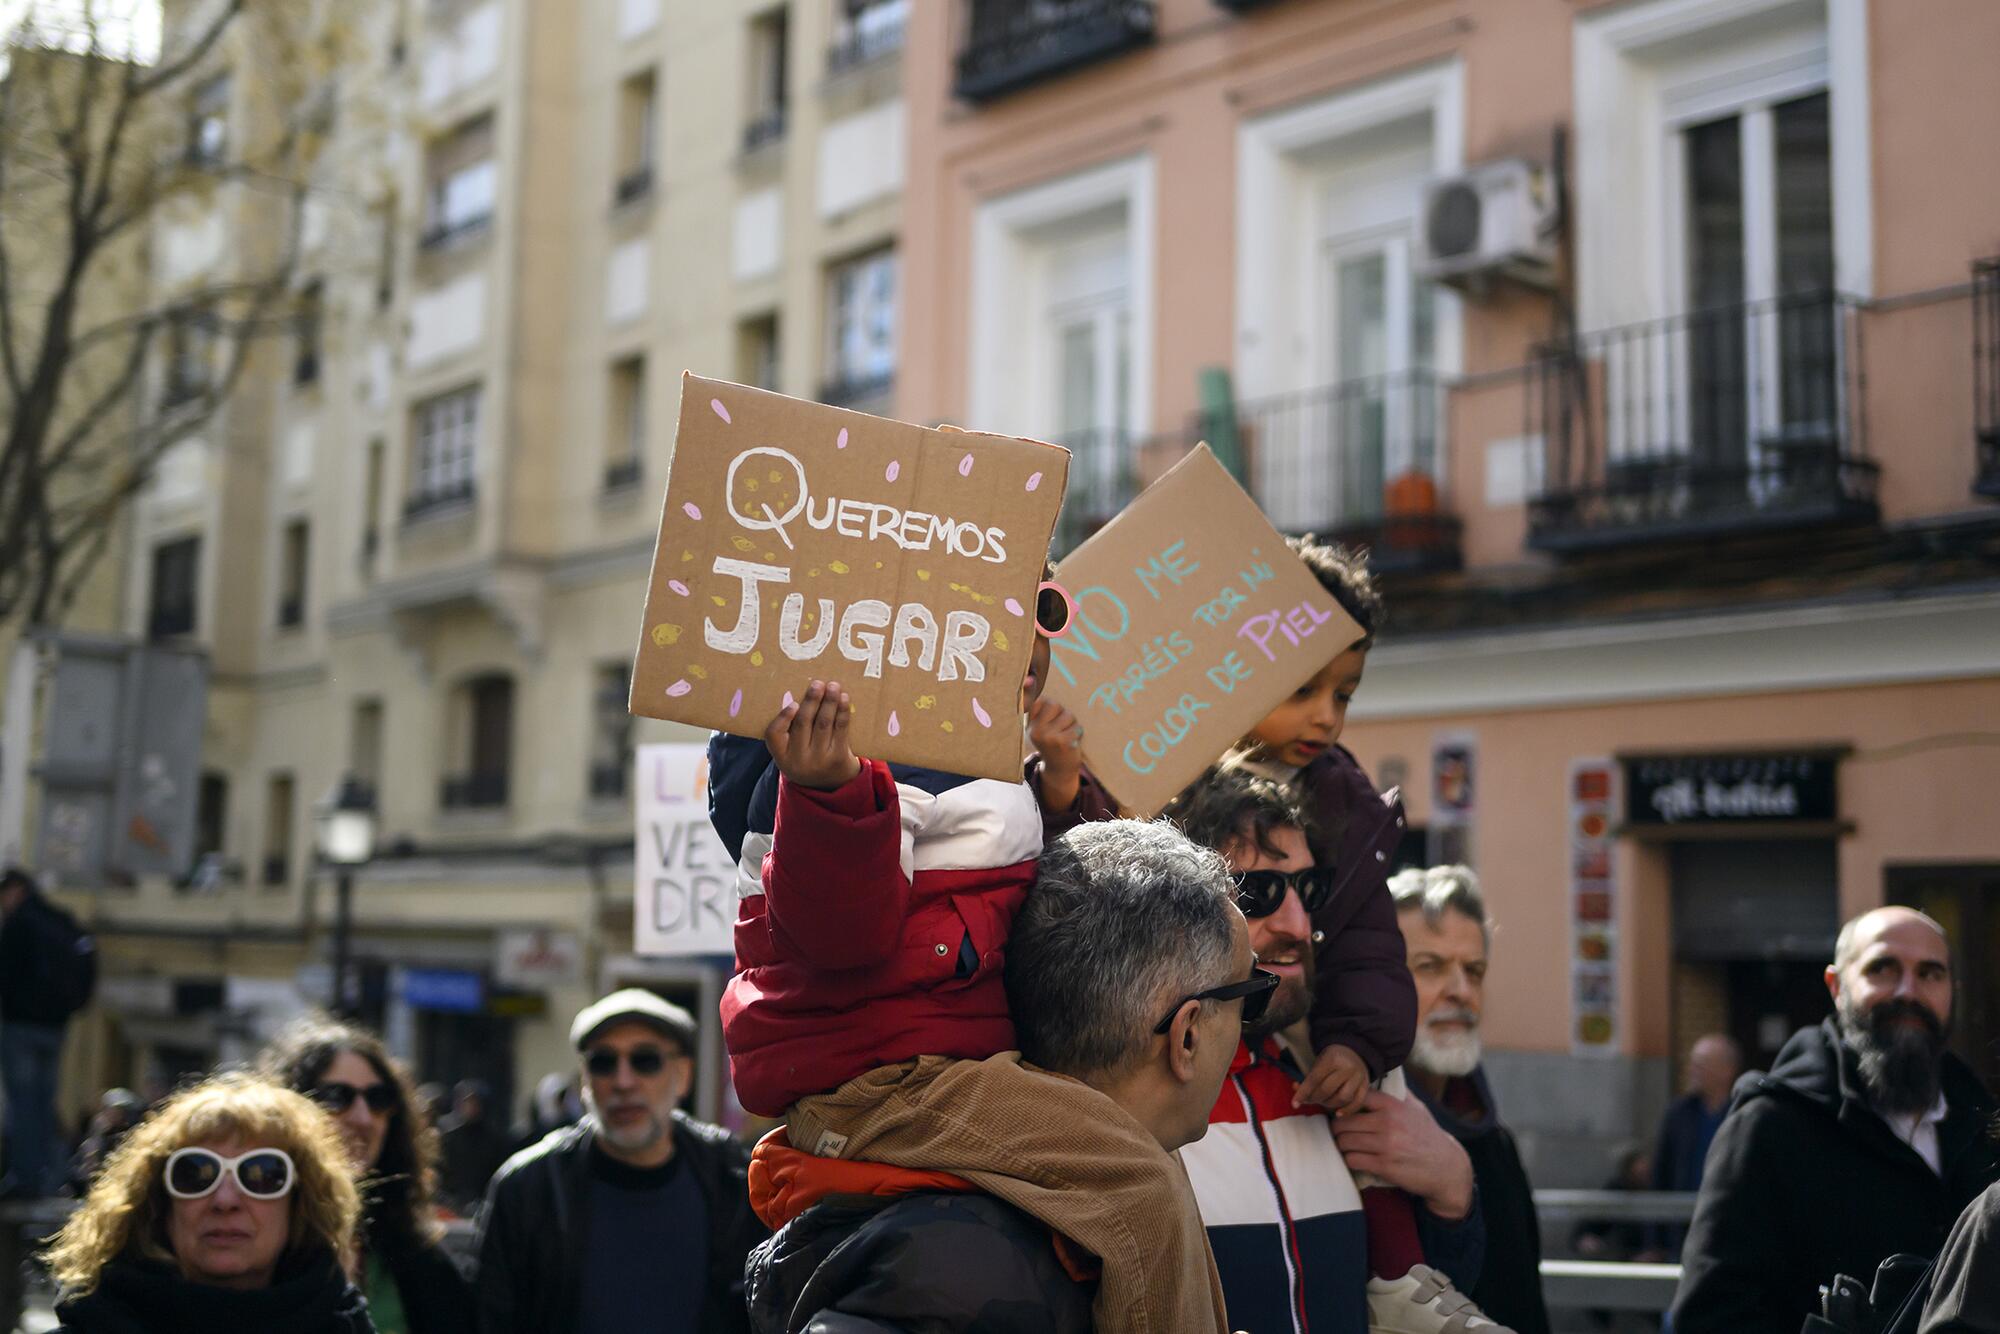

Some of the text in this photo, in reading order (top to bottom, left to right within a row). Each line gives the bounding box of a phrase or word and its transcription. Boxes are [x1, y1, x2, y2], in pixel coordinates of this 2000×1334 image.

[726, 447, 1007, 563] QUEREMOS
[704, 556, 991, 682] JUGAR
[1050, 539, 1200, 687] NO ME
[1192, 587, 1247, 629] POR
[1123, 693, 1210, 774] COLOR
[1206, 651, 1252, 693] DE
